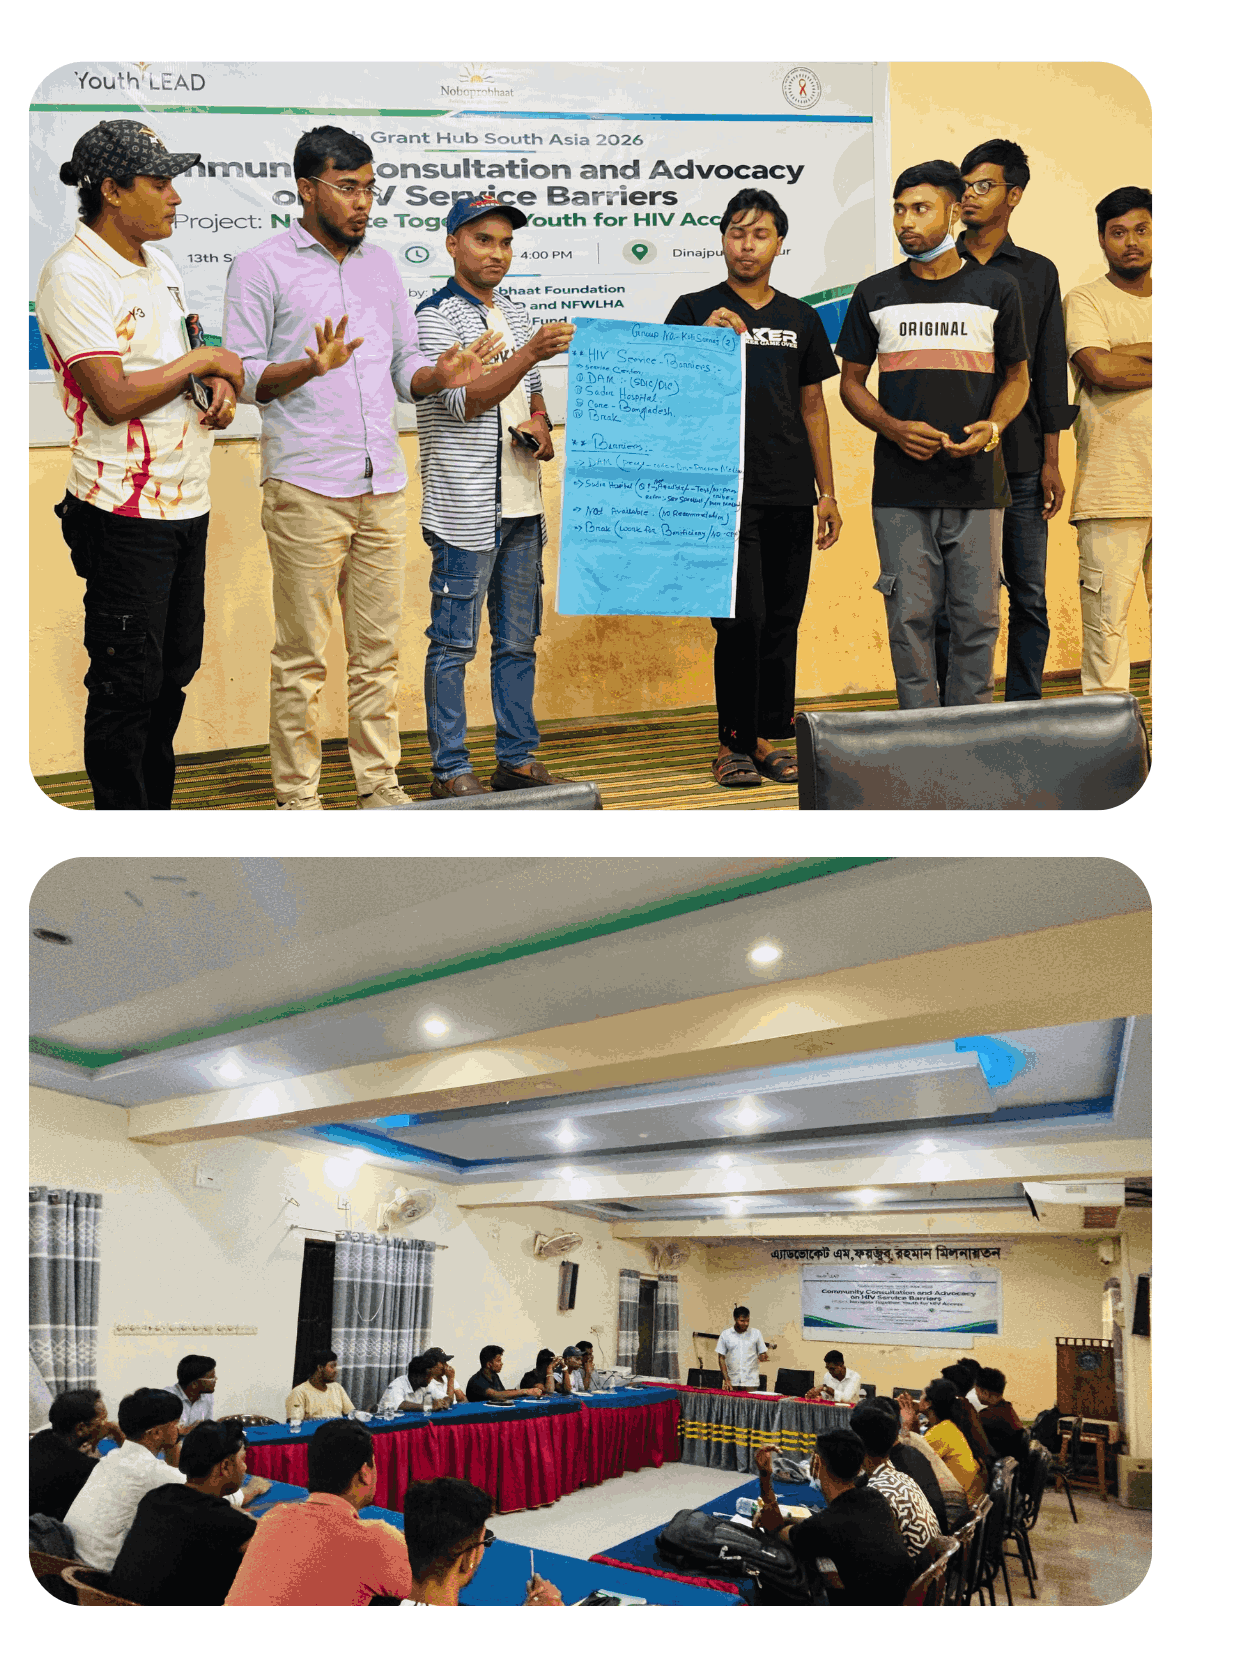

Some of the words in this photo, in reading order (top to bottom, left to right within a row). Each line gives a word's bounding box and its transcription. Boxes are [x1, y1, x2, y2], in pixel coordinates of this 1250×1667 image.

[74, 71, 139, 90] Youth
[150, 73, 206, 91] LEAD
[370, 131, 431, 144] Grant
[437, 132, 478, 144] Hub
[484, 132, 543, 145] South
[549, 133, 590, 146] Asia
[596, 134, 643, 146] 2026
[376, 158, 571, 180] onsultation
[579, 159, 641, 180] and
[648, 159, 805, 184] Advocacy
[547, 185, 678, 206] Barriers
[174, 213, 262, 232] Project:
[593, 213, 627, 228] for
[634, 213, 675, 228] HIV
[680, 213, 722, 227] Acc
[187, 254, 219, 263] 13th
[520, 251, 548, 260] 4:00
[552, 250, 573, 259] PM
[408, 288, 428, 299] by:
[545, 285, 625, 294] Foundation
[530, 301, 557, 310] and
[561, 299, 625, 309] NFWLHA
[899, 321, 968, 337] ORIGINAL
[589, 348, 609, 362] HIV
